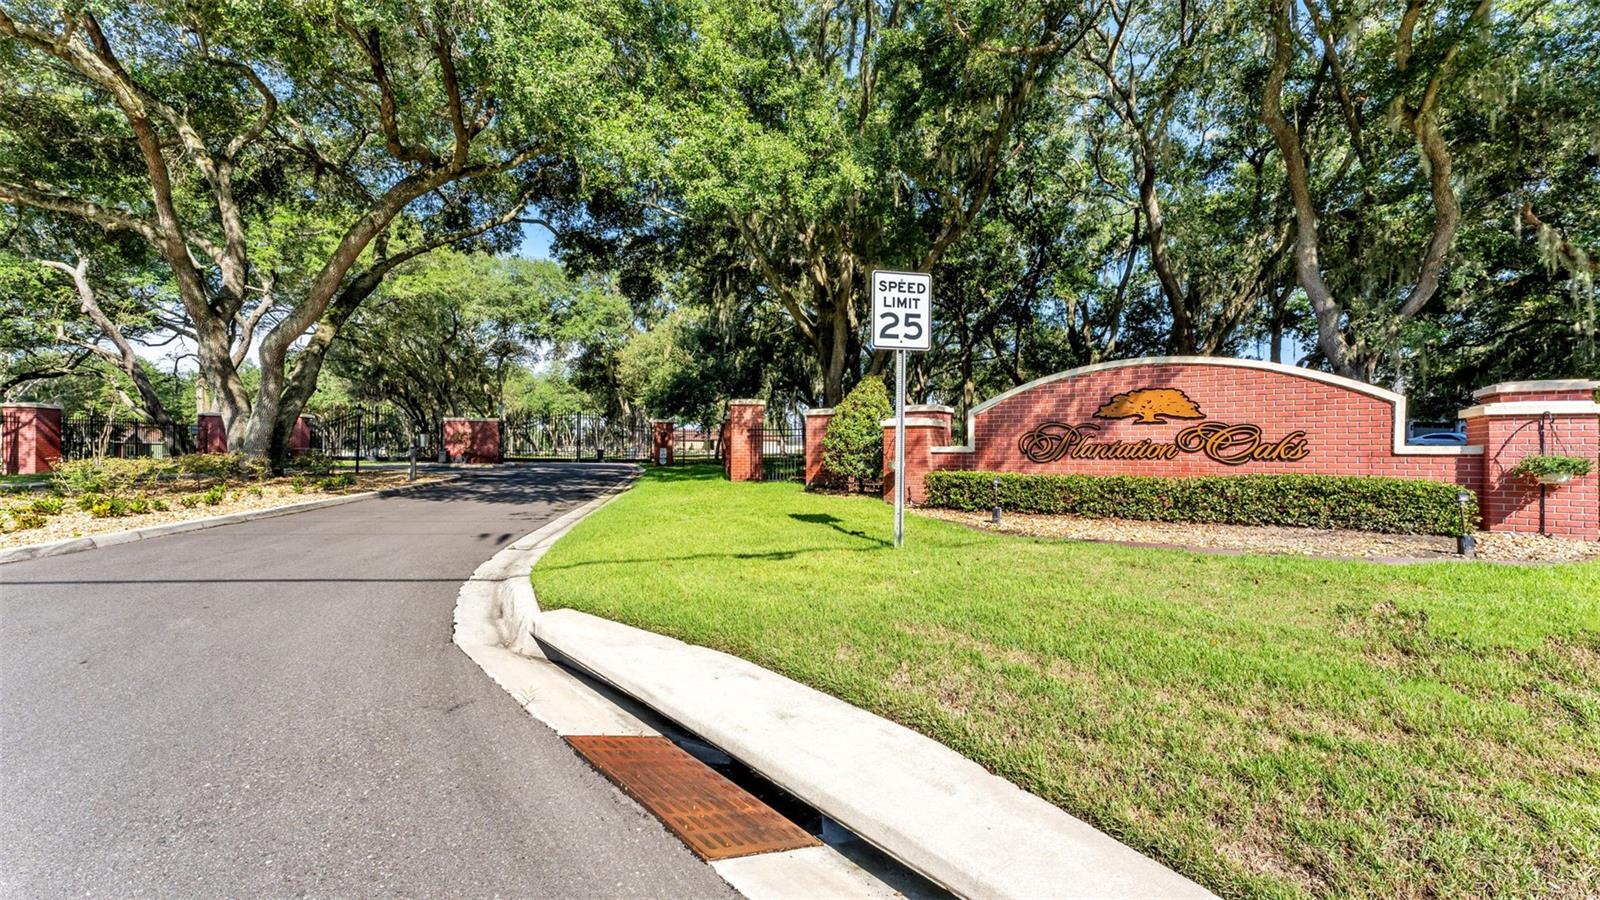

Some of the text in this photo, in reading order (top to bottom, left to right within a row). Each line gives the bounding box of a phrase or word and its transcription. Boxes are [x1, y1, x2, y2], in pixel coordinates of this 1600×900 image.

[878, 280, 927, 294] SPEED
[883, 296, 921, 309] LIMIT
[879, 312, 923, 340] 25
[1018, 421, 1310, 465] Plantation Oaks
